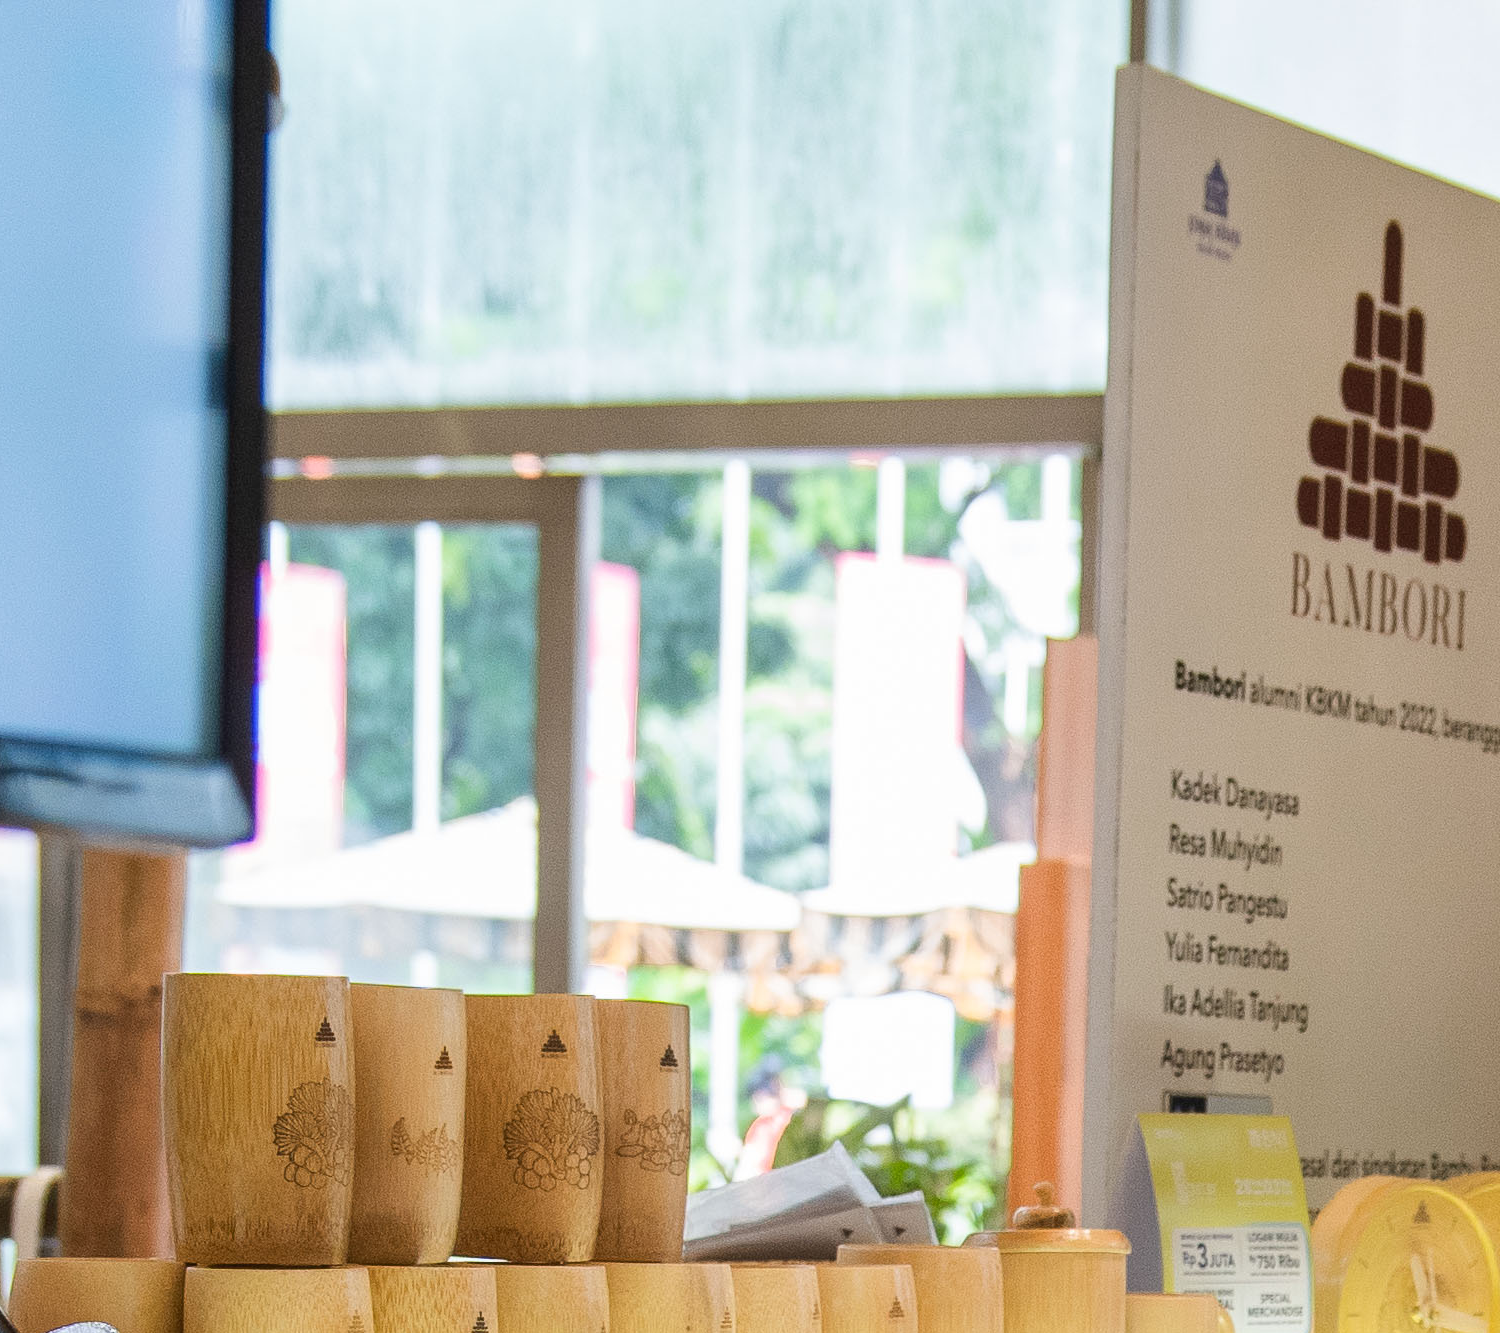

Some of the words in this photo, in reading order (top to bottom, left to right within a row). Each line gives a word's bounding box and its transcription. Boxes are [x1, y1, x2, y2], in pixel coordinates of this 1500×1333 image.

[1291, 551, 1467, 651] BAMBORI
[1175, 660, 1246, 701] Bambori
[1250, 675, 1302, 711] alumni
[1355, 696, 1397, 728] tahun
[1171, 769, 1222, 805] Kadek
[1225, 778, 1299, 820] Danayasa
[1169, 823, 1206, 858] Resa
[1166, 877, 1213, 911] Satrio
[1217, 883, 1288, 924] Pangestu
[1164, 931, 1203, 963] Yulia
[1164, 984, 1187, 1016] Ika
[1249, 990, 1308, 1034] Tanjung
[1161, 1040, 1215, 1079] Agung
[1218, 1042, 1284, 1082] Prasetyo
[1197, 1243, 1208, 1268] 3
[1210, 1253, 1236, 1268] JUTA
